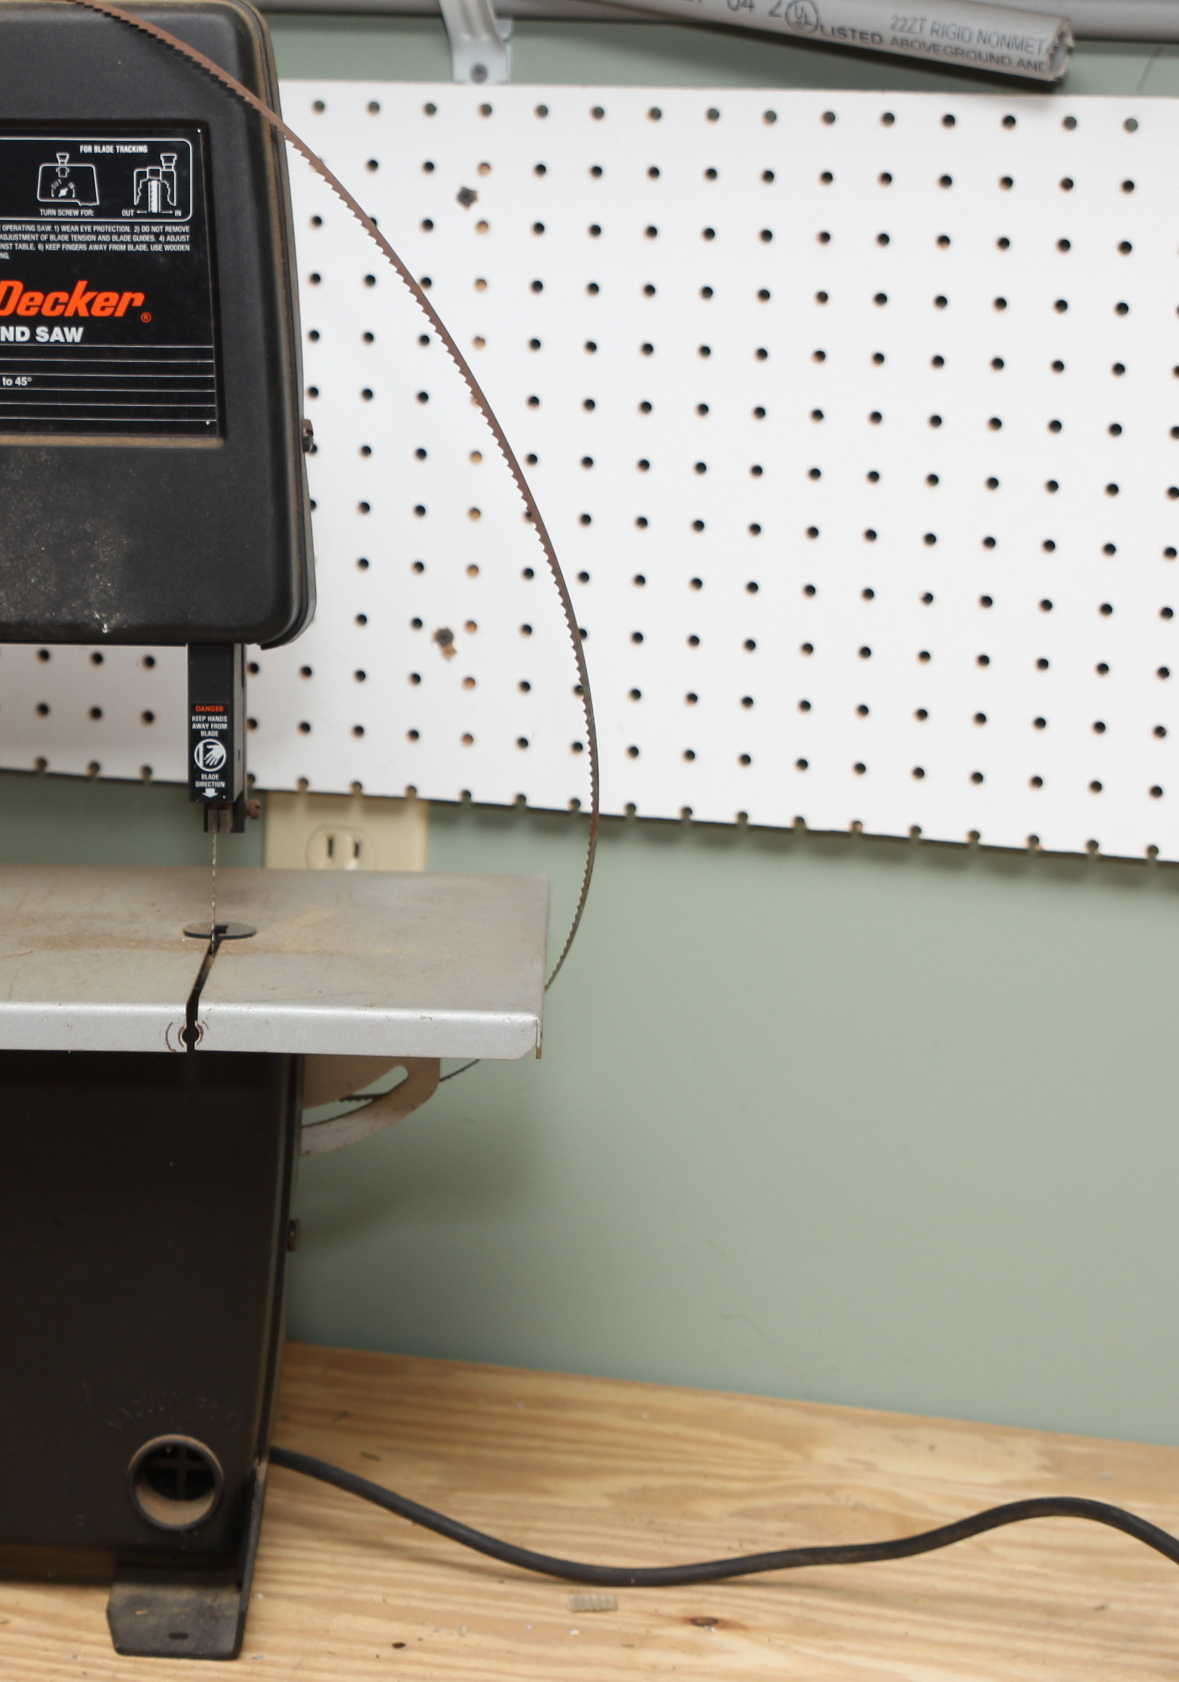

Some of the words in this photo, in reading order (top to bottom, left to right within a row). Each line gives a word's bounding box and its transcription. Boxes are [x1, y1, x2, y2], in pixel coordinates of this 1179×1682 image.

[929, 19, 971, 44] RIGID
[820, 24, 883, 45] LISTED
[890, 36, 1010, 68] ABOVEGROUND
[80, 145, 92, 153] FOR
[94, 145, 114, 153] BLADE
[116, 145, 148, 153] TRACKING
[81, 209, 94, 217] FOR:
[2, 224, 35, 232] OPERATING
[54, 224, 59, 232] 1)
[61, 224, 79, 232] WEAR
[80, 224, 92, 232] EYE
[134, 225, 140, 233] 2)
[141, 225, 149, 233] DO
[151, 225, 164, 233] NOT
[165, 225, 190, 233] REMOVE
[0, 233, 39, 241] ADJUSTMENT
[40, 233, 48, 241] OF
[49, 233, 69, 241] BLADE
[159, 234, 164, 242] 4)
[166, 234, 190, 242] ADJUST
[38, 243, 44, 251] 6)
[45, 243, 60, 251] KEEP
[62, 243, 87, 251] FINGERS
[88, 243, 107, 251] AWAY
[35, 326, 84, 343] SAW
[2, 377, 13, 386] to
[15, 377, 32, 386] 45°
